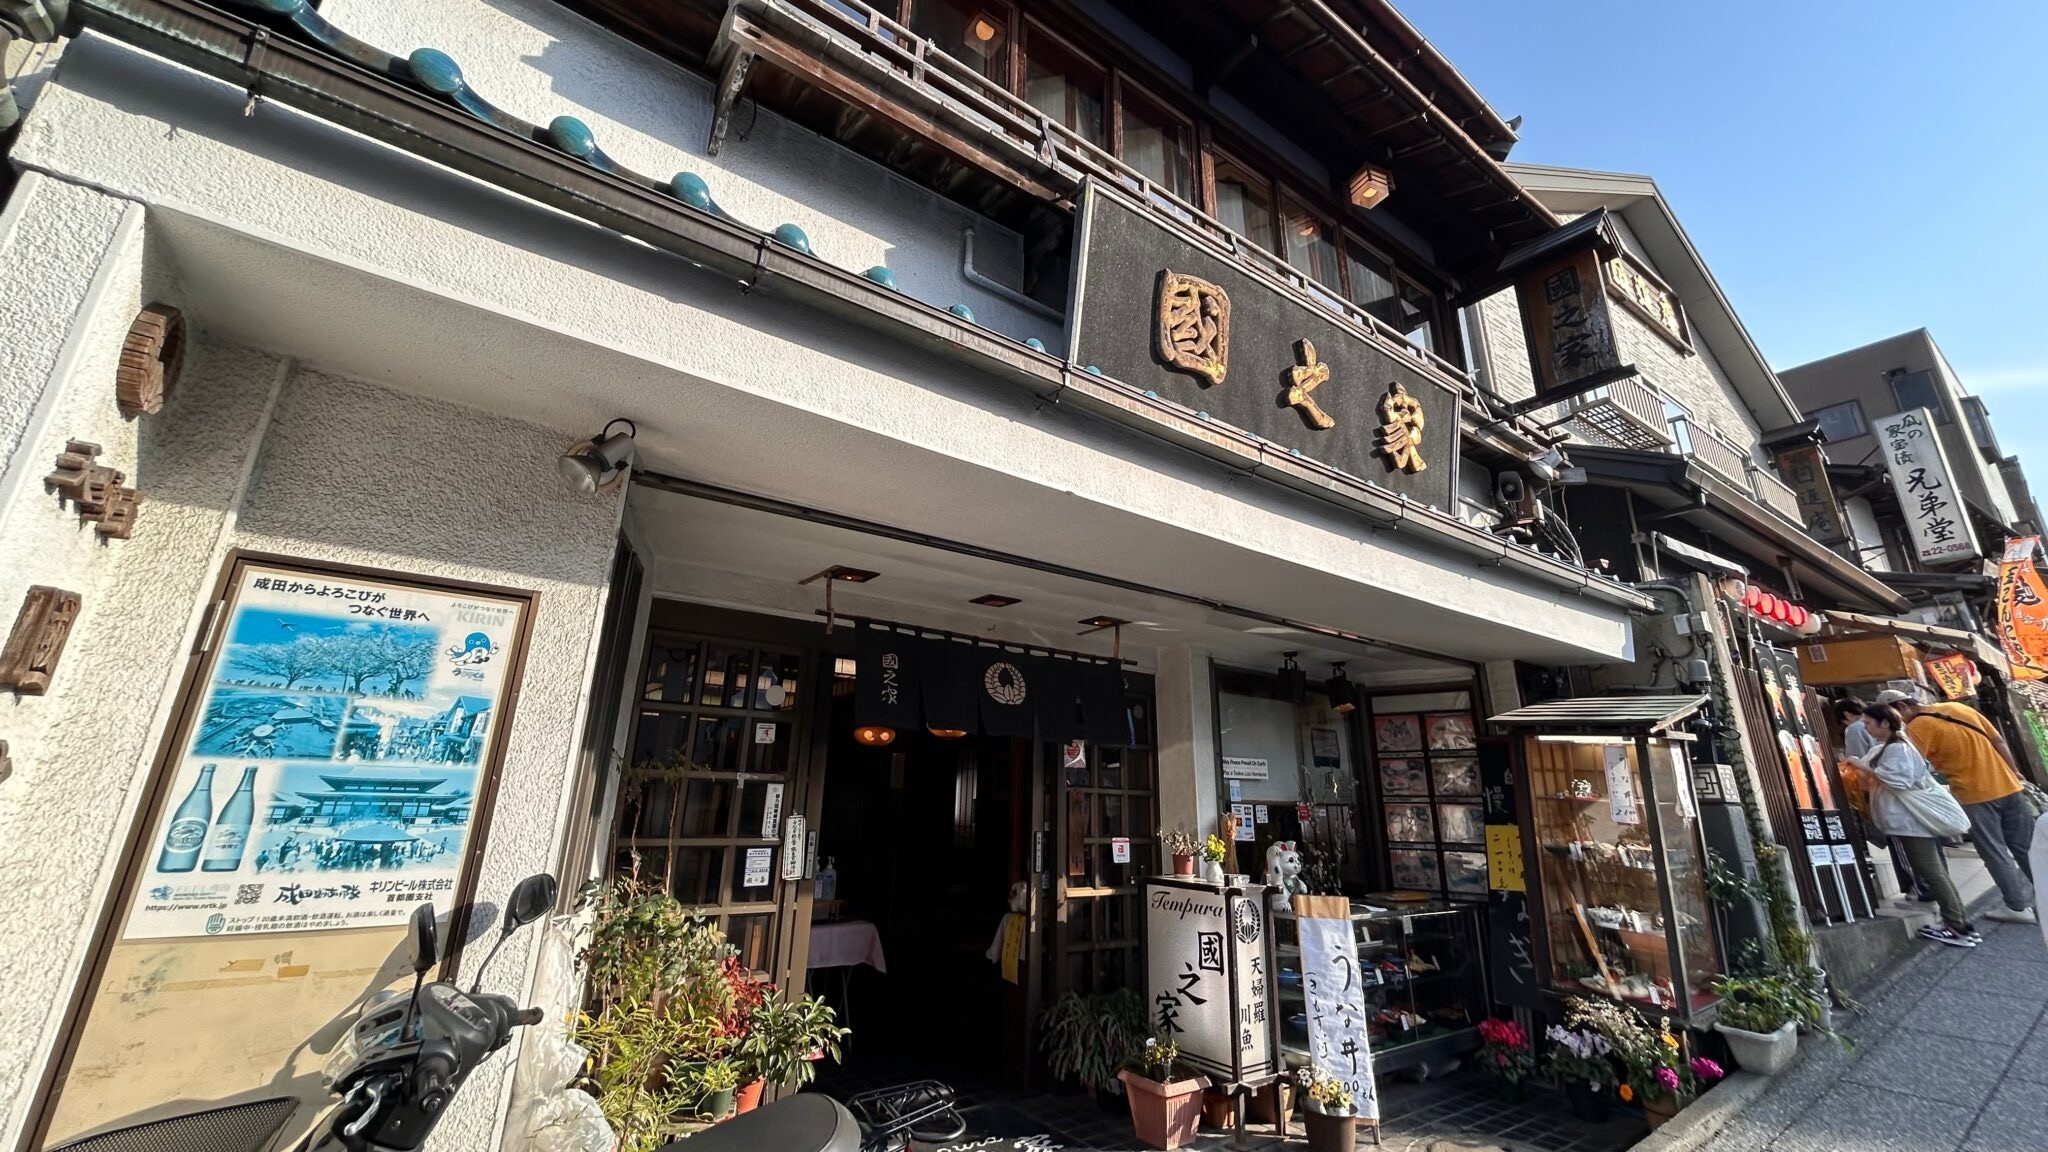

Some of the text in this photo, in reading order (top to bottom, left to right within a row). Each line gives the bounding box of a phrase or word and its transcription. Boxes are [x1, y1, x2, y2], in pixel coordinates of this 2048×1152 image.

[1905, 467, 1956, 544] 兄弟堂
[253, 577, 386, 604] 成田からよろこびが
[348, 603, 431, 622] つなぐ世界へ
[451, 602, 515, 614] よろこびがつなぐ世界へ
[457, 611, 505, 627] KIRIN
[369, 878, 454, 893] キリンビール株式会社
[145, 902, 227, 912] https://www.nrtk.jp
[387, 892, 433, 903] 首都圏支社
[1151, 891, 1224, 920] Tempura
[1155, 930, 1225, 1034] 國之家
[1250, 957, 1266, 1024] 天婦羅
[1240, 1004, 1254, 1053] 川魚
